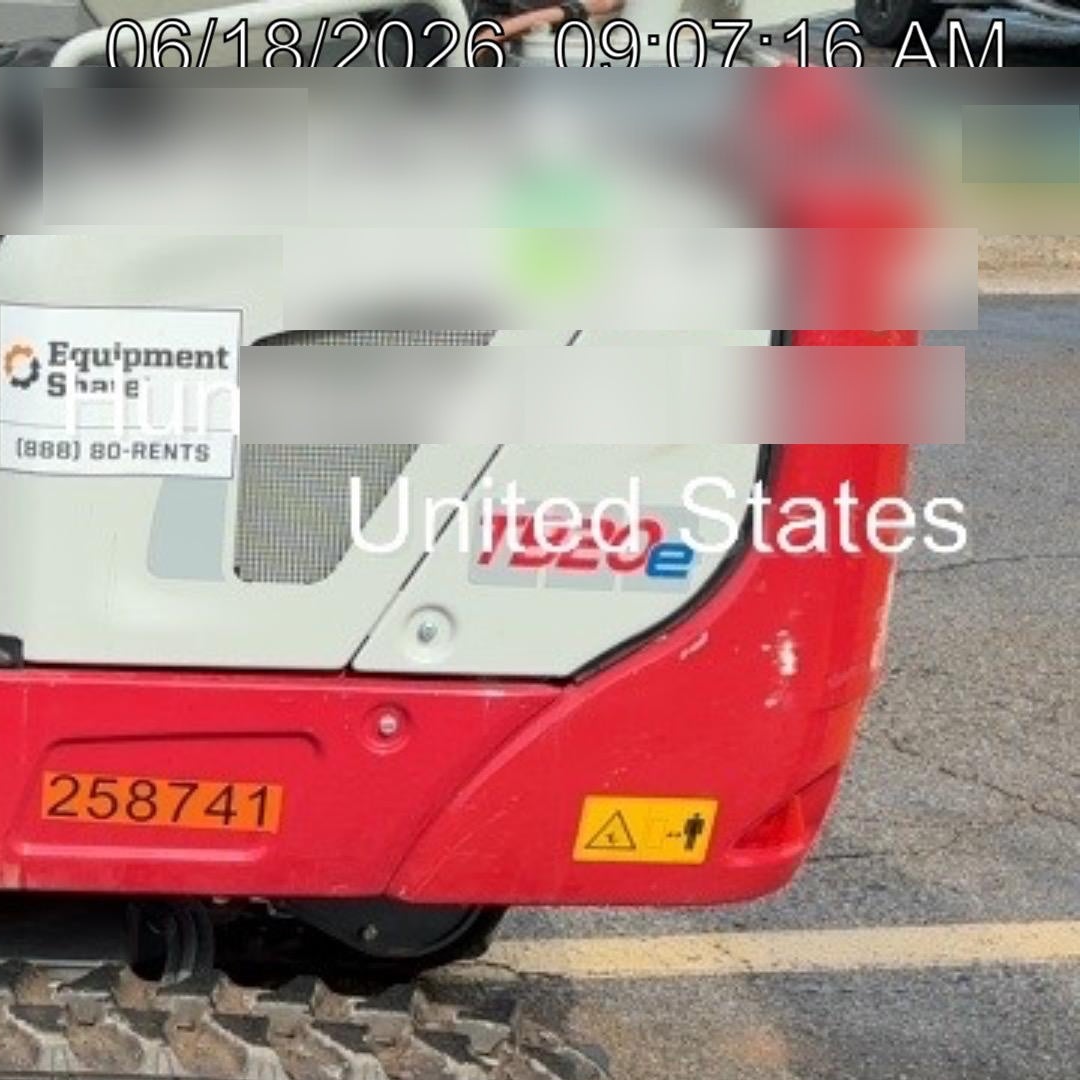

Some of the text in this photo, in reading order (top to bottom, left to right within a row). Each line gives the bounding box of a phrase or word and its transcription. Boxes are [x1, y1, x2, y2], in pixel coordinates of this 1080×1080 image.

[47, 341, 230, 373] Equipment
[89, 440, 210, 463] 80-RENTS
[47, 773, 269, 827] 258741
